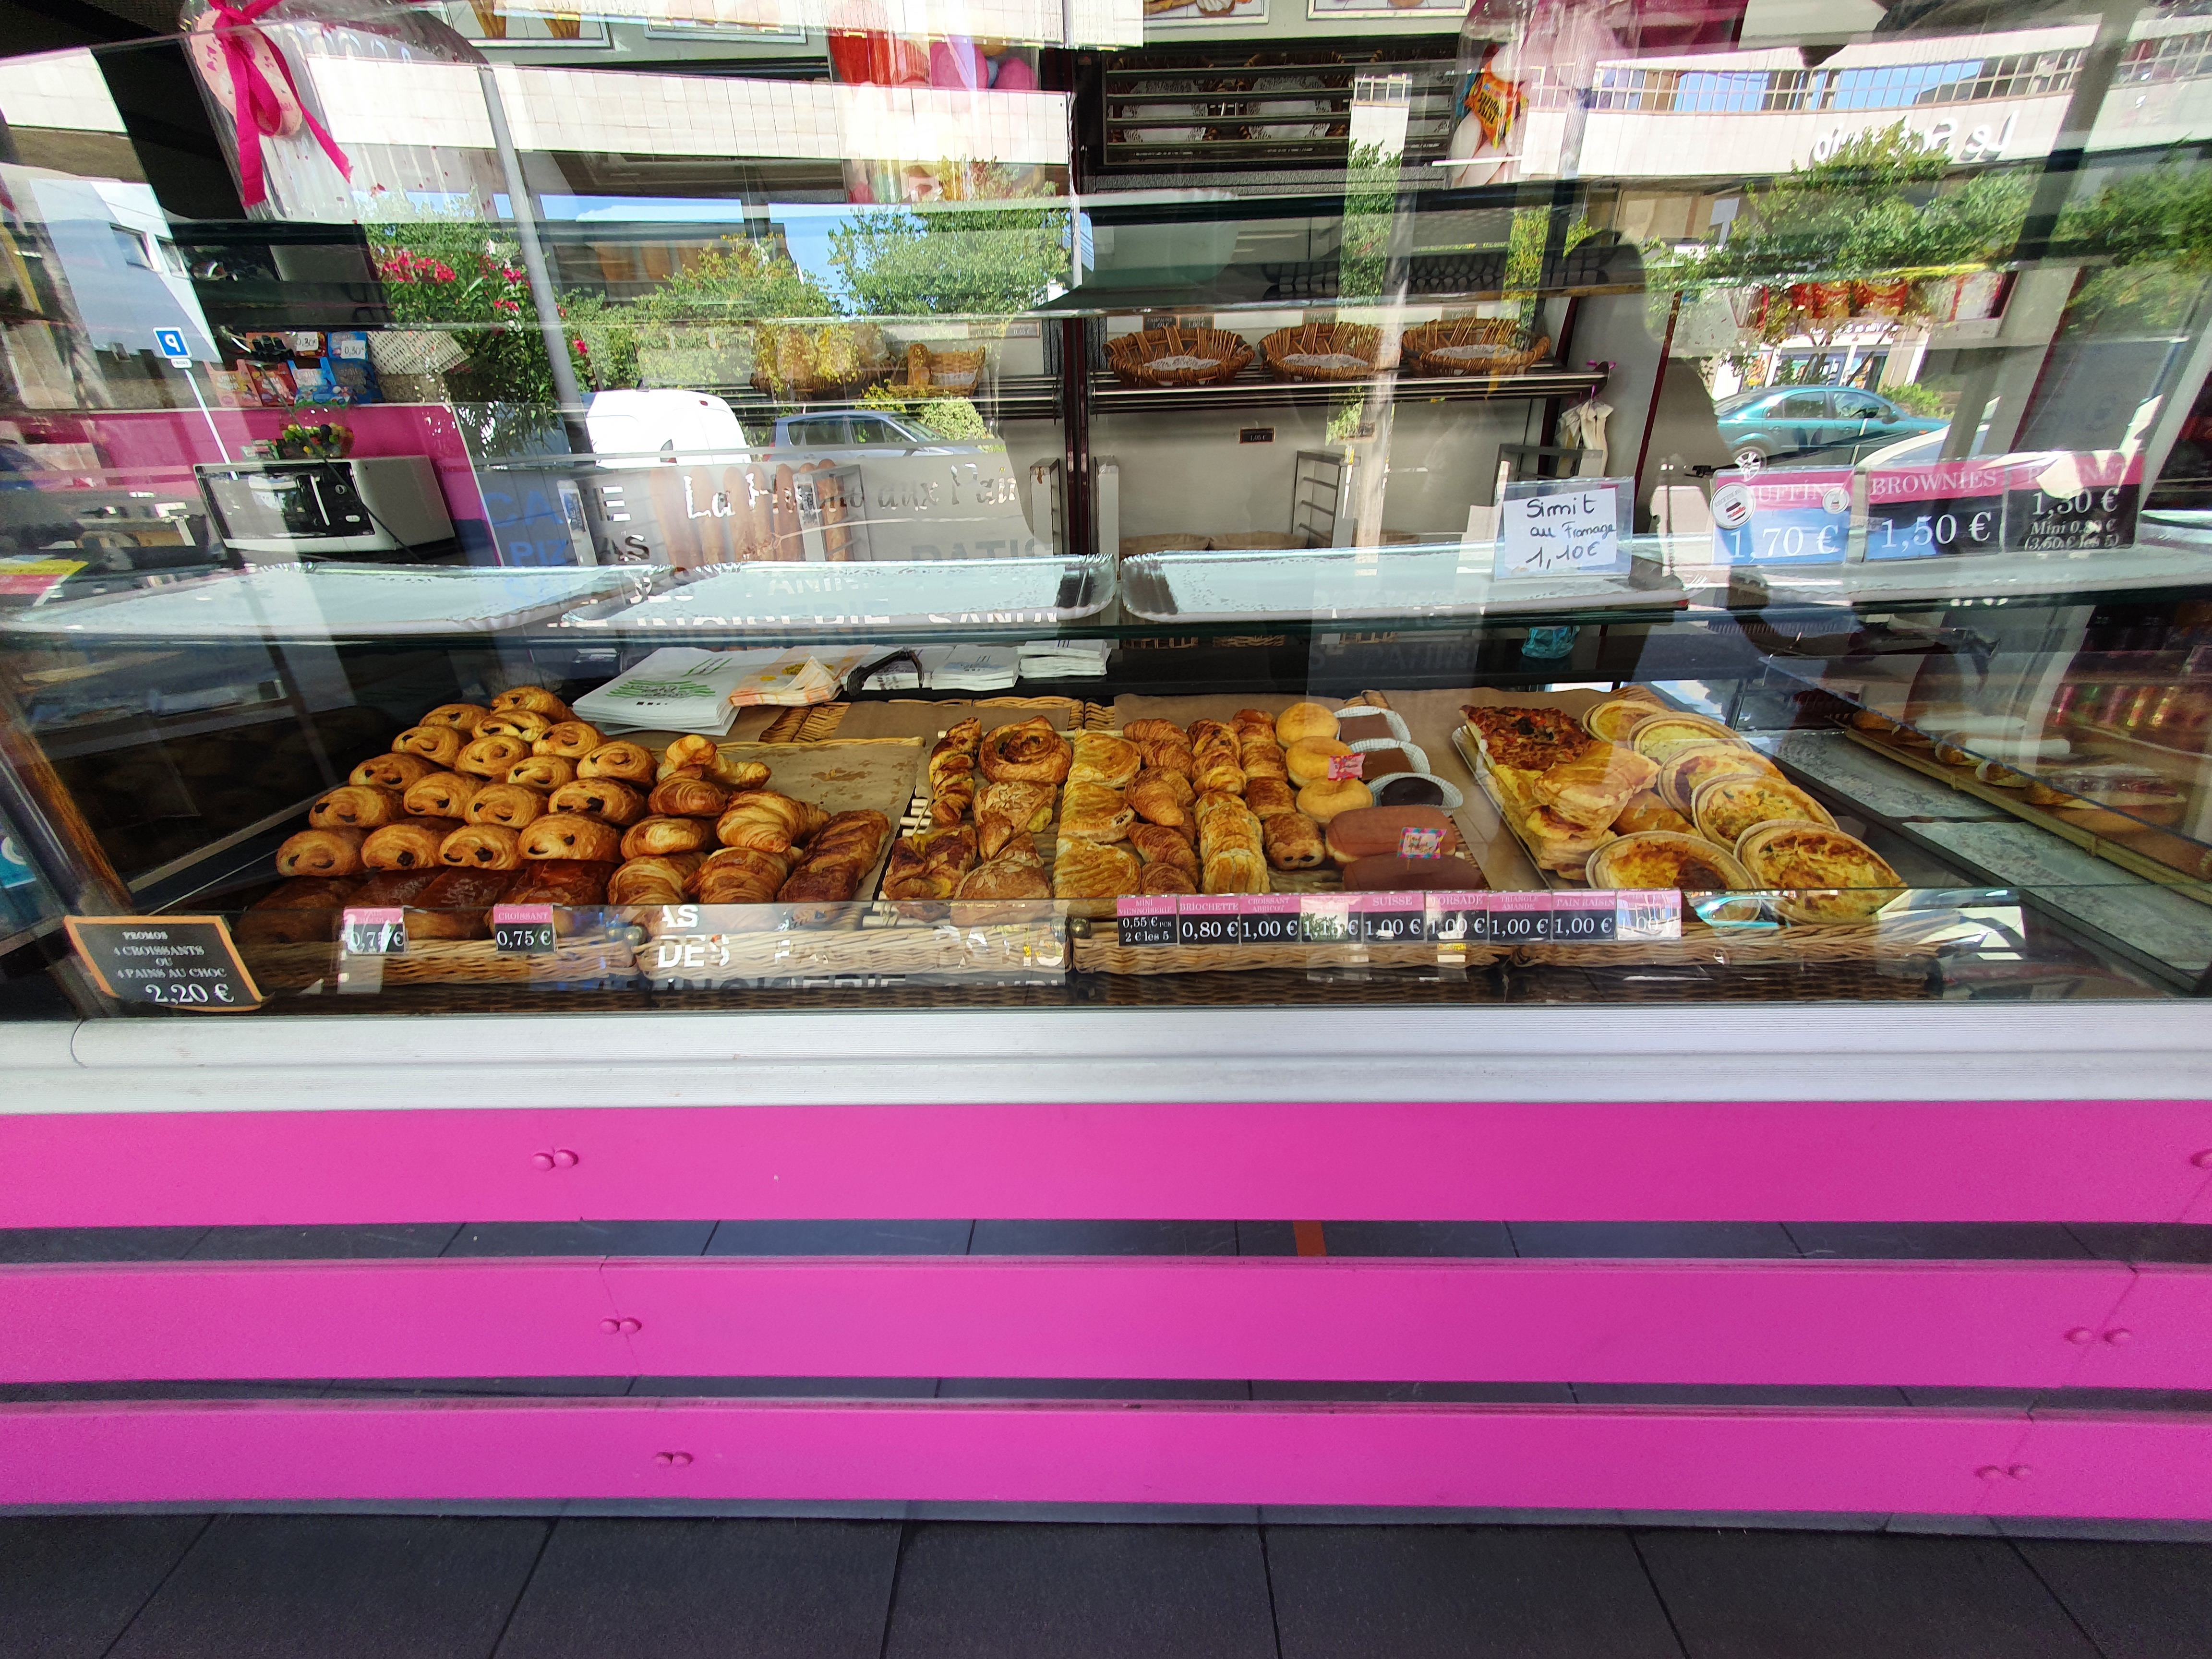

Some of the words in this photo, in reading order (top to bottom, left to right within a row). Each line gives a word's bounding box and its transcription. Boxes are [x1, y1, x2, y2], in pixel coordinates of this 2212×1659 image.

[1527, 494, 1597, 518] Simit
[2101, 488, 2118, 512] €
[1530, 526, 1556, 538] au
[1881, 514, 1958, 552] 1,50
[1969, 512, 1992, 542] €
[1730, 527, 1803, 564] 1,70
[1816, 524, 1840, 555] €
[1123, 916, 1147, 929] 0,55
[1151, 916, 1158, 927] €
[1182, 921, 1221, 940] 0,80
[1227, 921, 1238, 937] €
[1243, 920, 1281, 940] 1,00
[1286, 920, 1298, 936] €
[1348, 919, 1359, 936] €
[1410, 918, 1421, 935] €
[1473, 917, 1485, 934] €
[1491, 918, 1530, 938] 1,00
[1536, 918, 1549, 934] €
[1555, 917, 1595, 937] 1,00
[1601, 917, 1612, 934] €
[497, 930, 534, 949] 0,75
[541, 930, 551, 946] €
[1125, 932, 1131, 942] 2
[1134, 932, 1141, 942] €
[1163, 930, 1169, 941] 5
[156, 957, 173, 966] OU
[169, 968, 187, 978] AU
[189, 968, 227, 977] CHOC
[145, 984, 208, 1005] 2,20
[214, 984, 234, 1003] €
